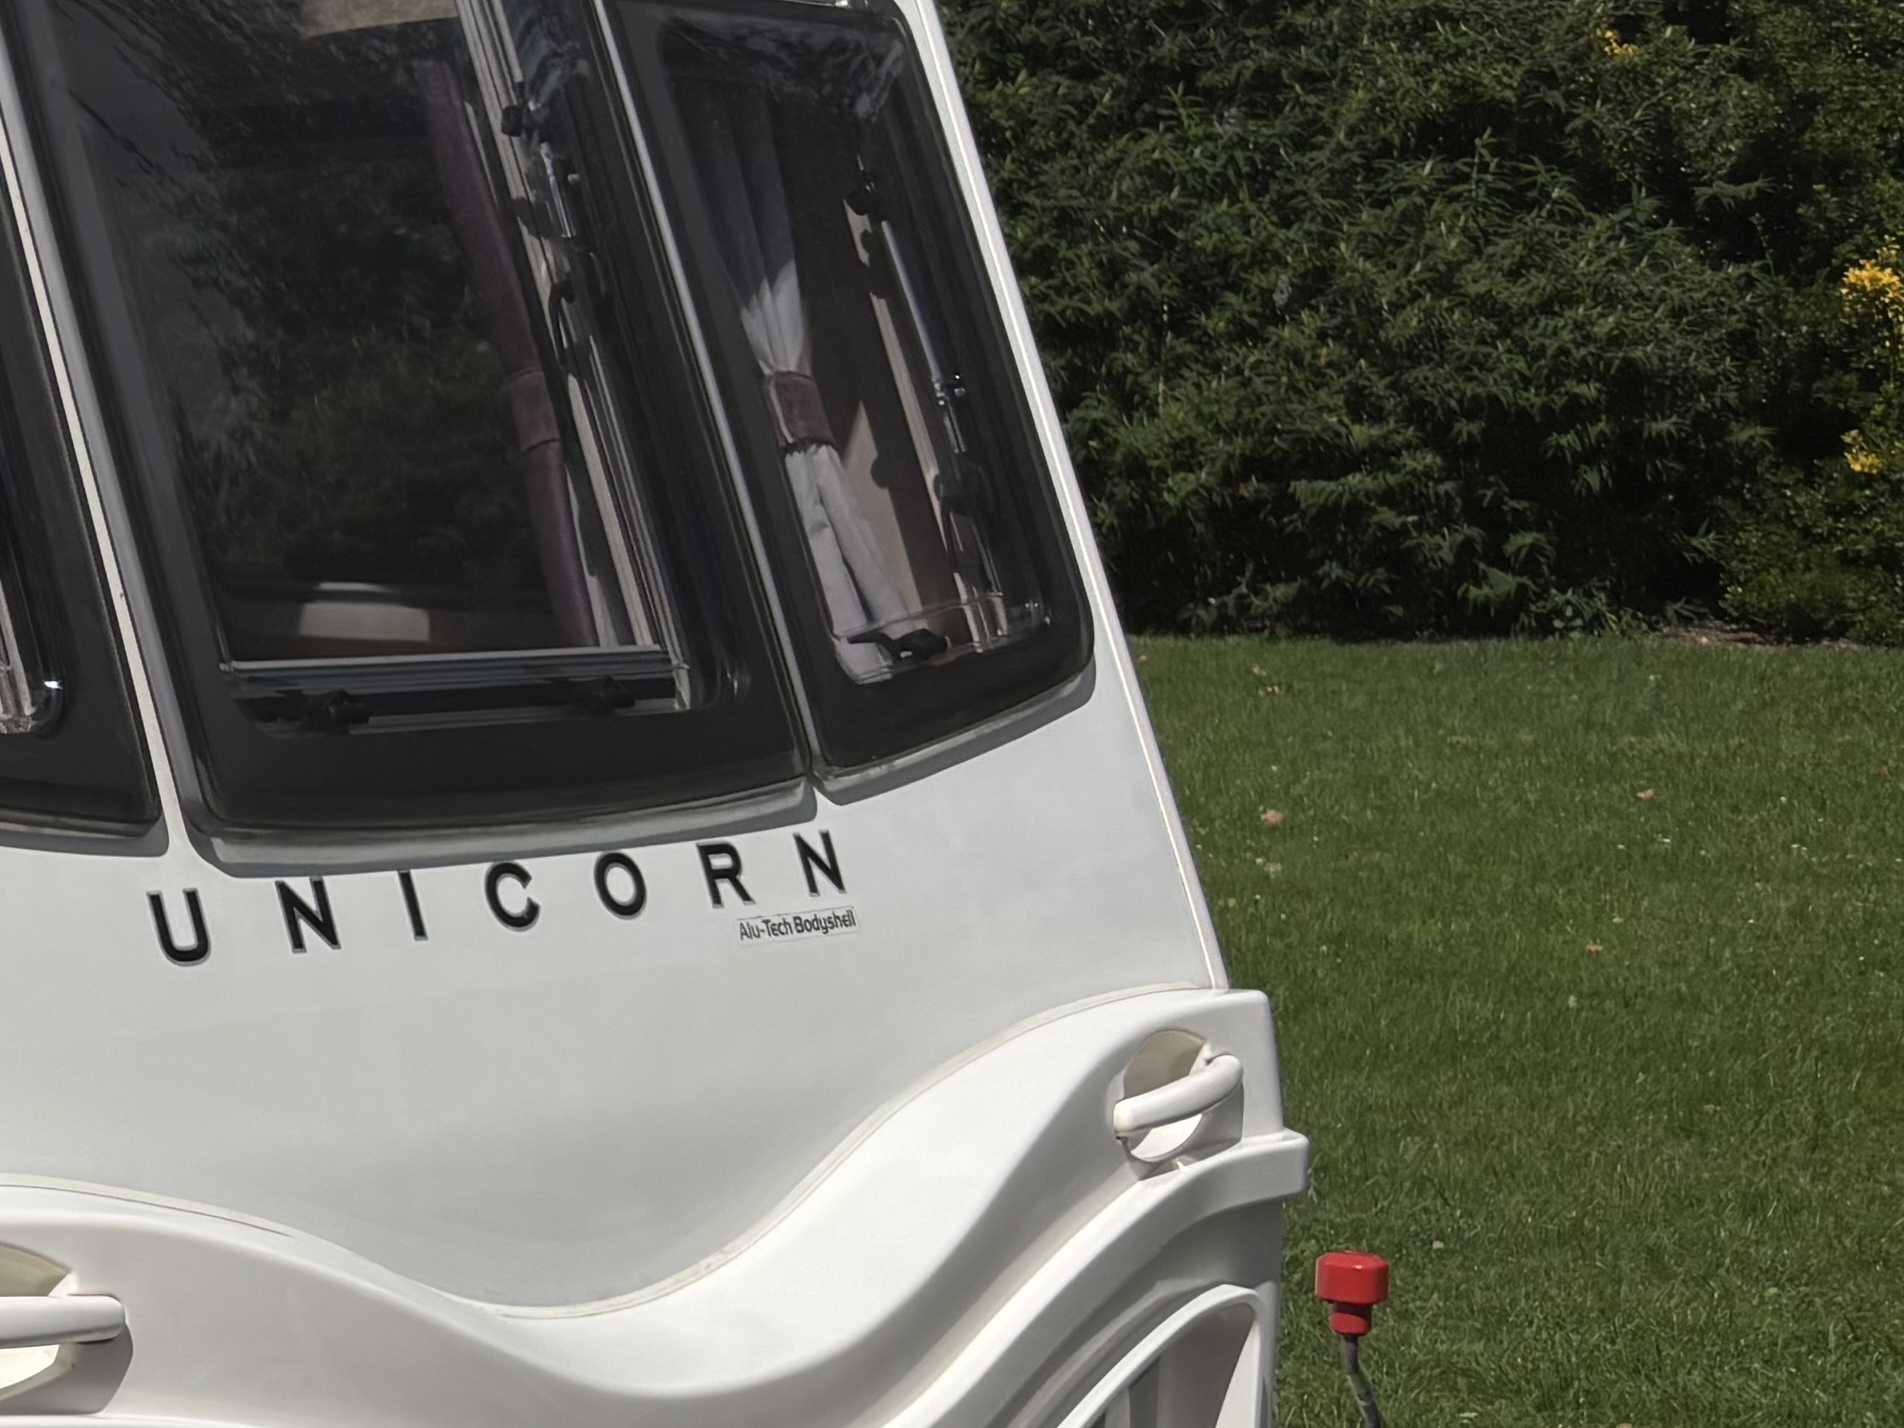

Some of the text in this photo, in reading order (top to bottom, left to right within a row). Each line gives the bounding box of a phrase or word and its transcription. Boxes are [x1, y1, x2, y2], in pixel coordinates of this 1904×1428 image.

[146, 829, 849, 967] UNICORN
[740, 909, 856, 940] Alu-Tech Bodyshell
